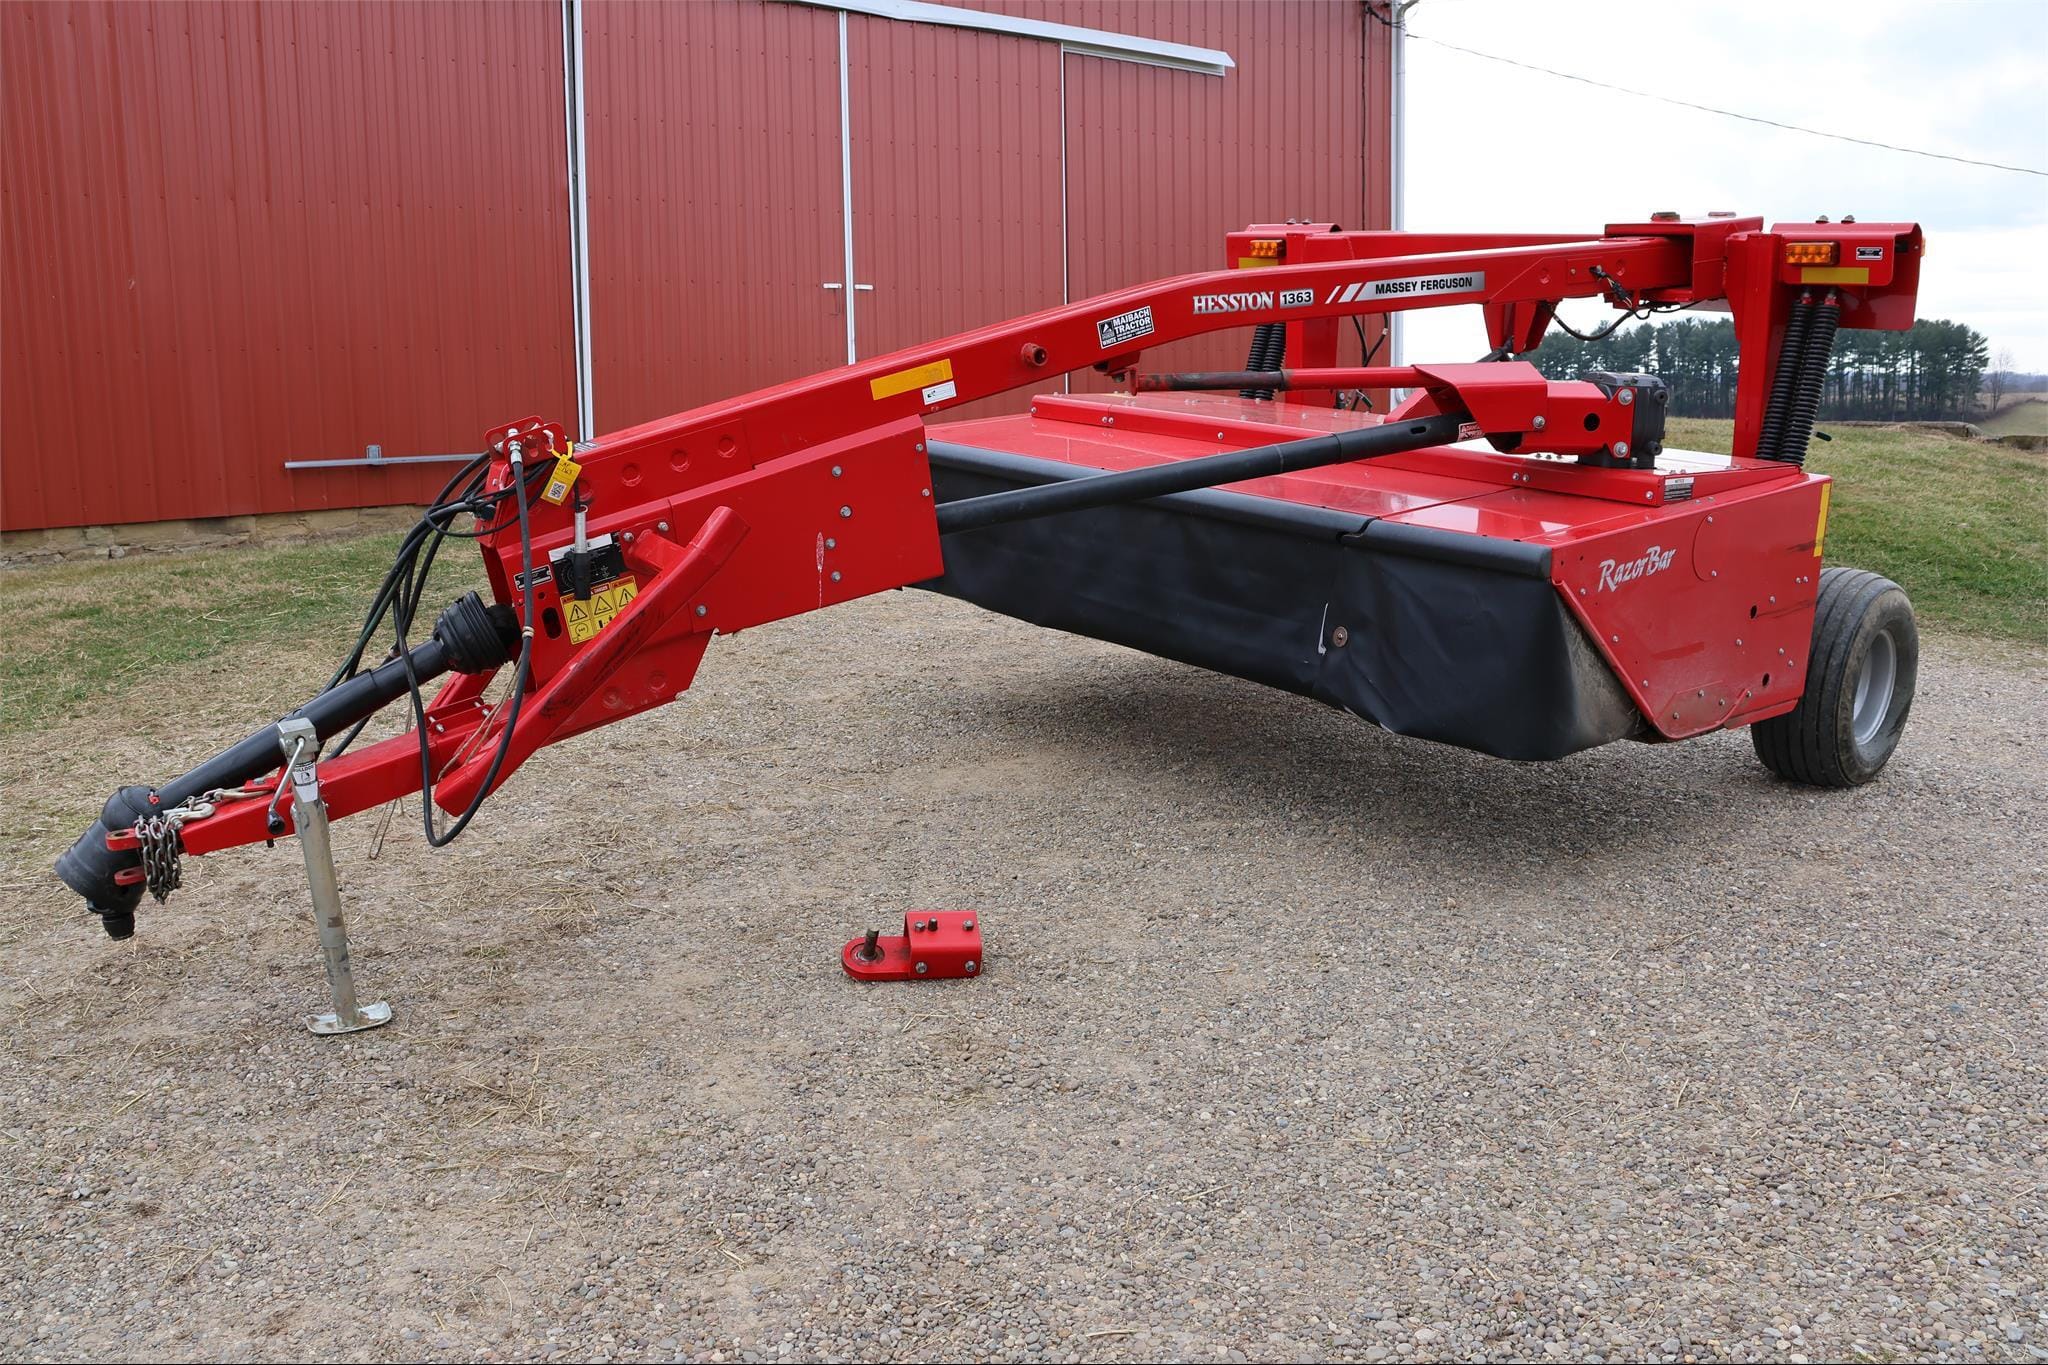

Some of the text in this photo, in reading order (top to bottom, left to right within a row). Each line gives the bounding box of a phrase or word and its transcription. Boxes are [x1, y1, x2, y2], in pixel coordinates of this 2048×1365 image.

[1375, 277, 1473, 294] MASSEY FERGUSON
[1193, 291, 1312, 314] HESSTON 1363
[1113, 309, 1150, 326] MAIBACH
[1114, 316, 1151, 335] TRACTOR
